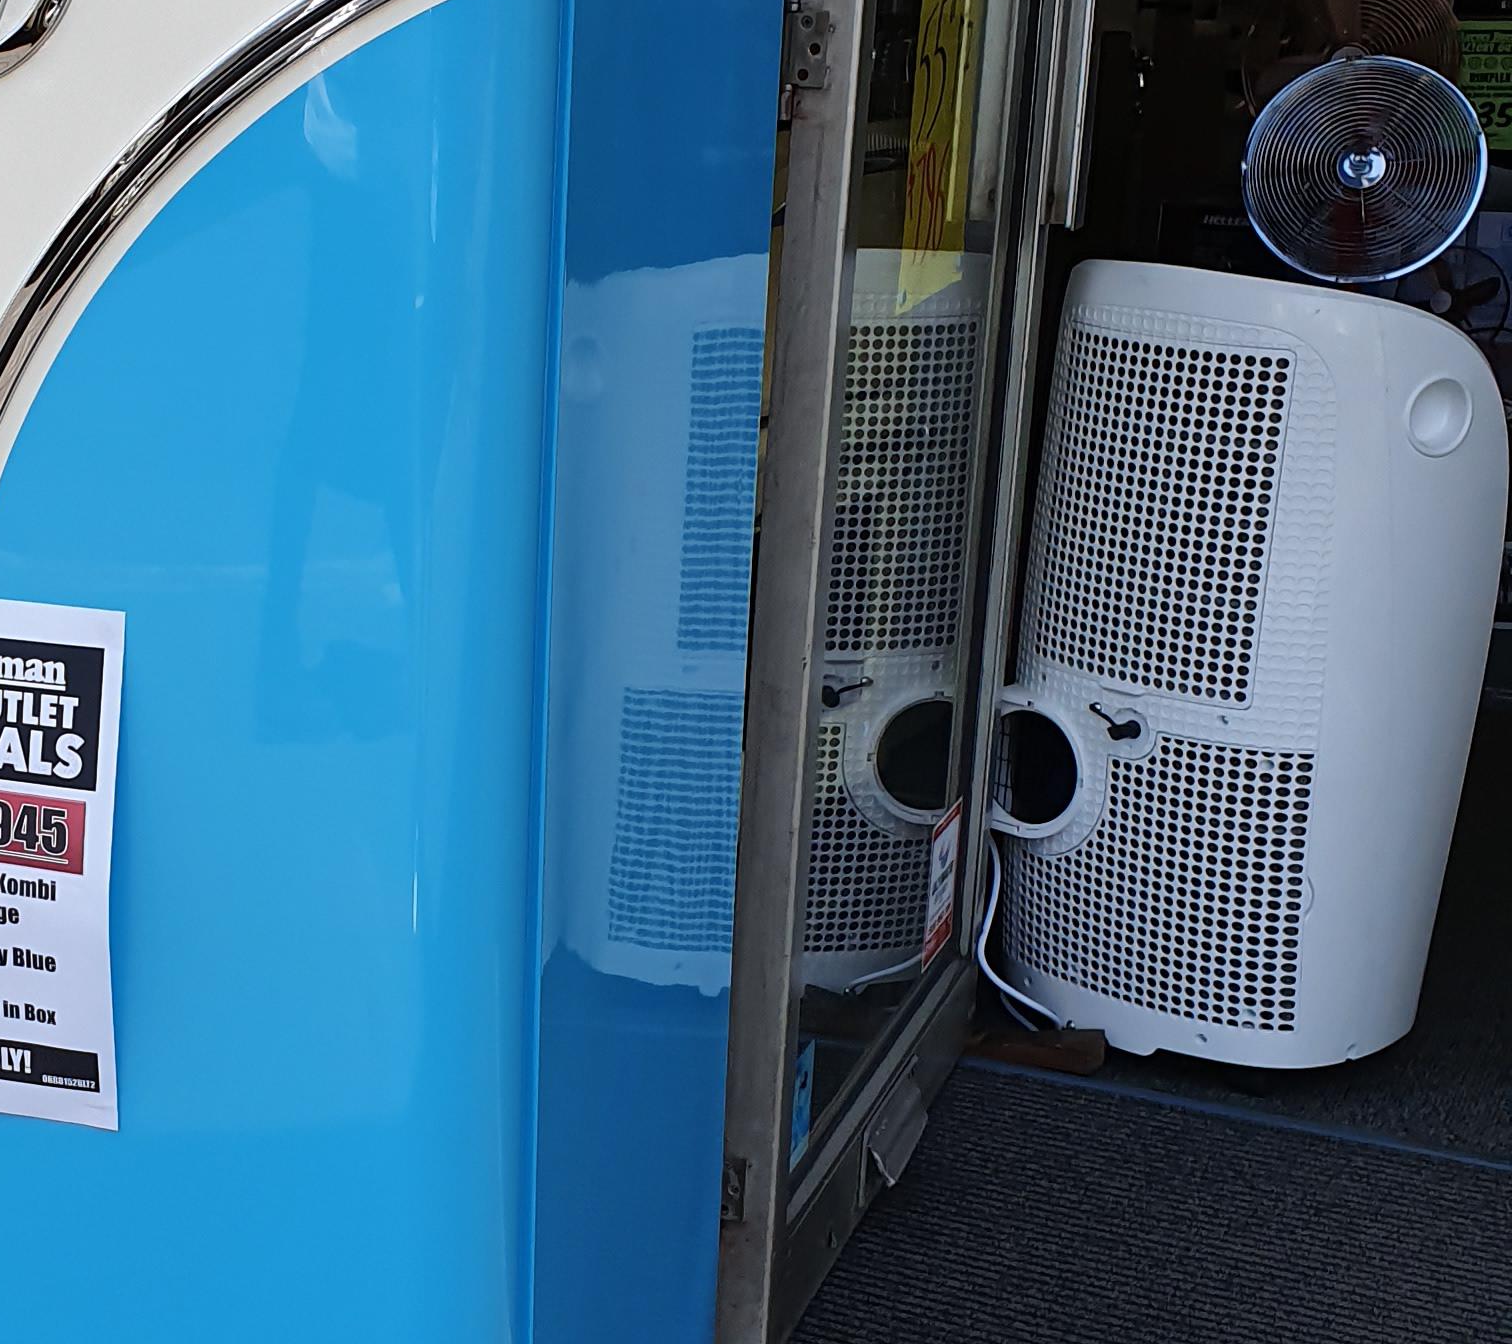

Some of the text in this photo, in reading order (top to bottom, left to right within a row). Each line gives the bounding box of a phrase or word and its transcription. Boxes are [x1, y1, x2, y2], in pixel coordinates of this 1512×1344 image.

[13, 947, 57, 972] Blue
[3, 1000, 20, 1019] in
[24, 1003, 57, 1025] Box
